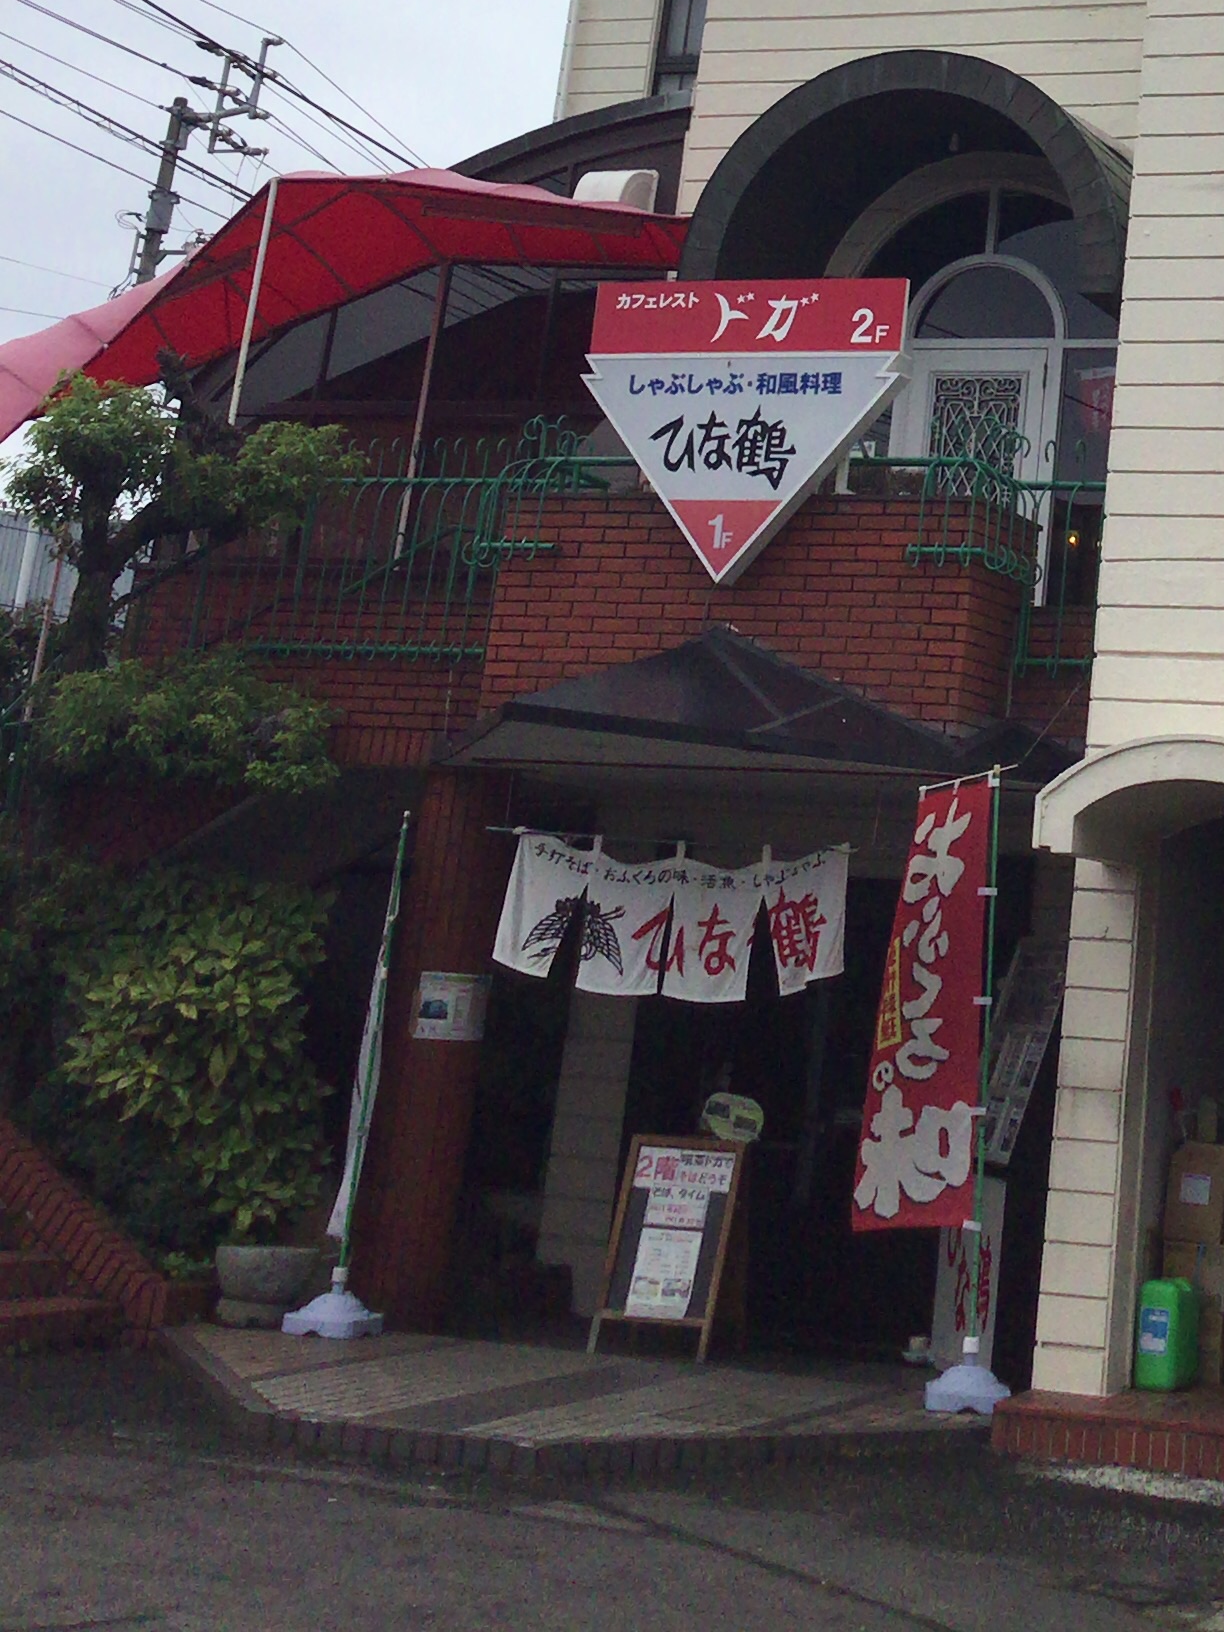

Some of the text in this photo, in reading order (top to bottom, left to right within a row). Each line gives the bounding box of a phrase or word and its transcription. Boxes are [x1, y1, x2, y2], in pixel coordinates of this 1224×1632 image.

[616, 292, 890, 344] カフェレスト ドガ 2F
[629, 372, 843, 395] しゃぶしゃぶ・和風料理
[649, 405, 797, 490] ひな鶴
[708, 514, 733, 549] 1F
[632, 886, 827, 977] ひな鶴
